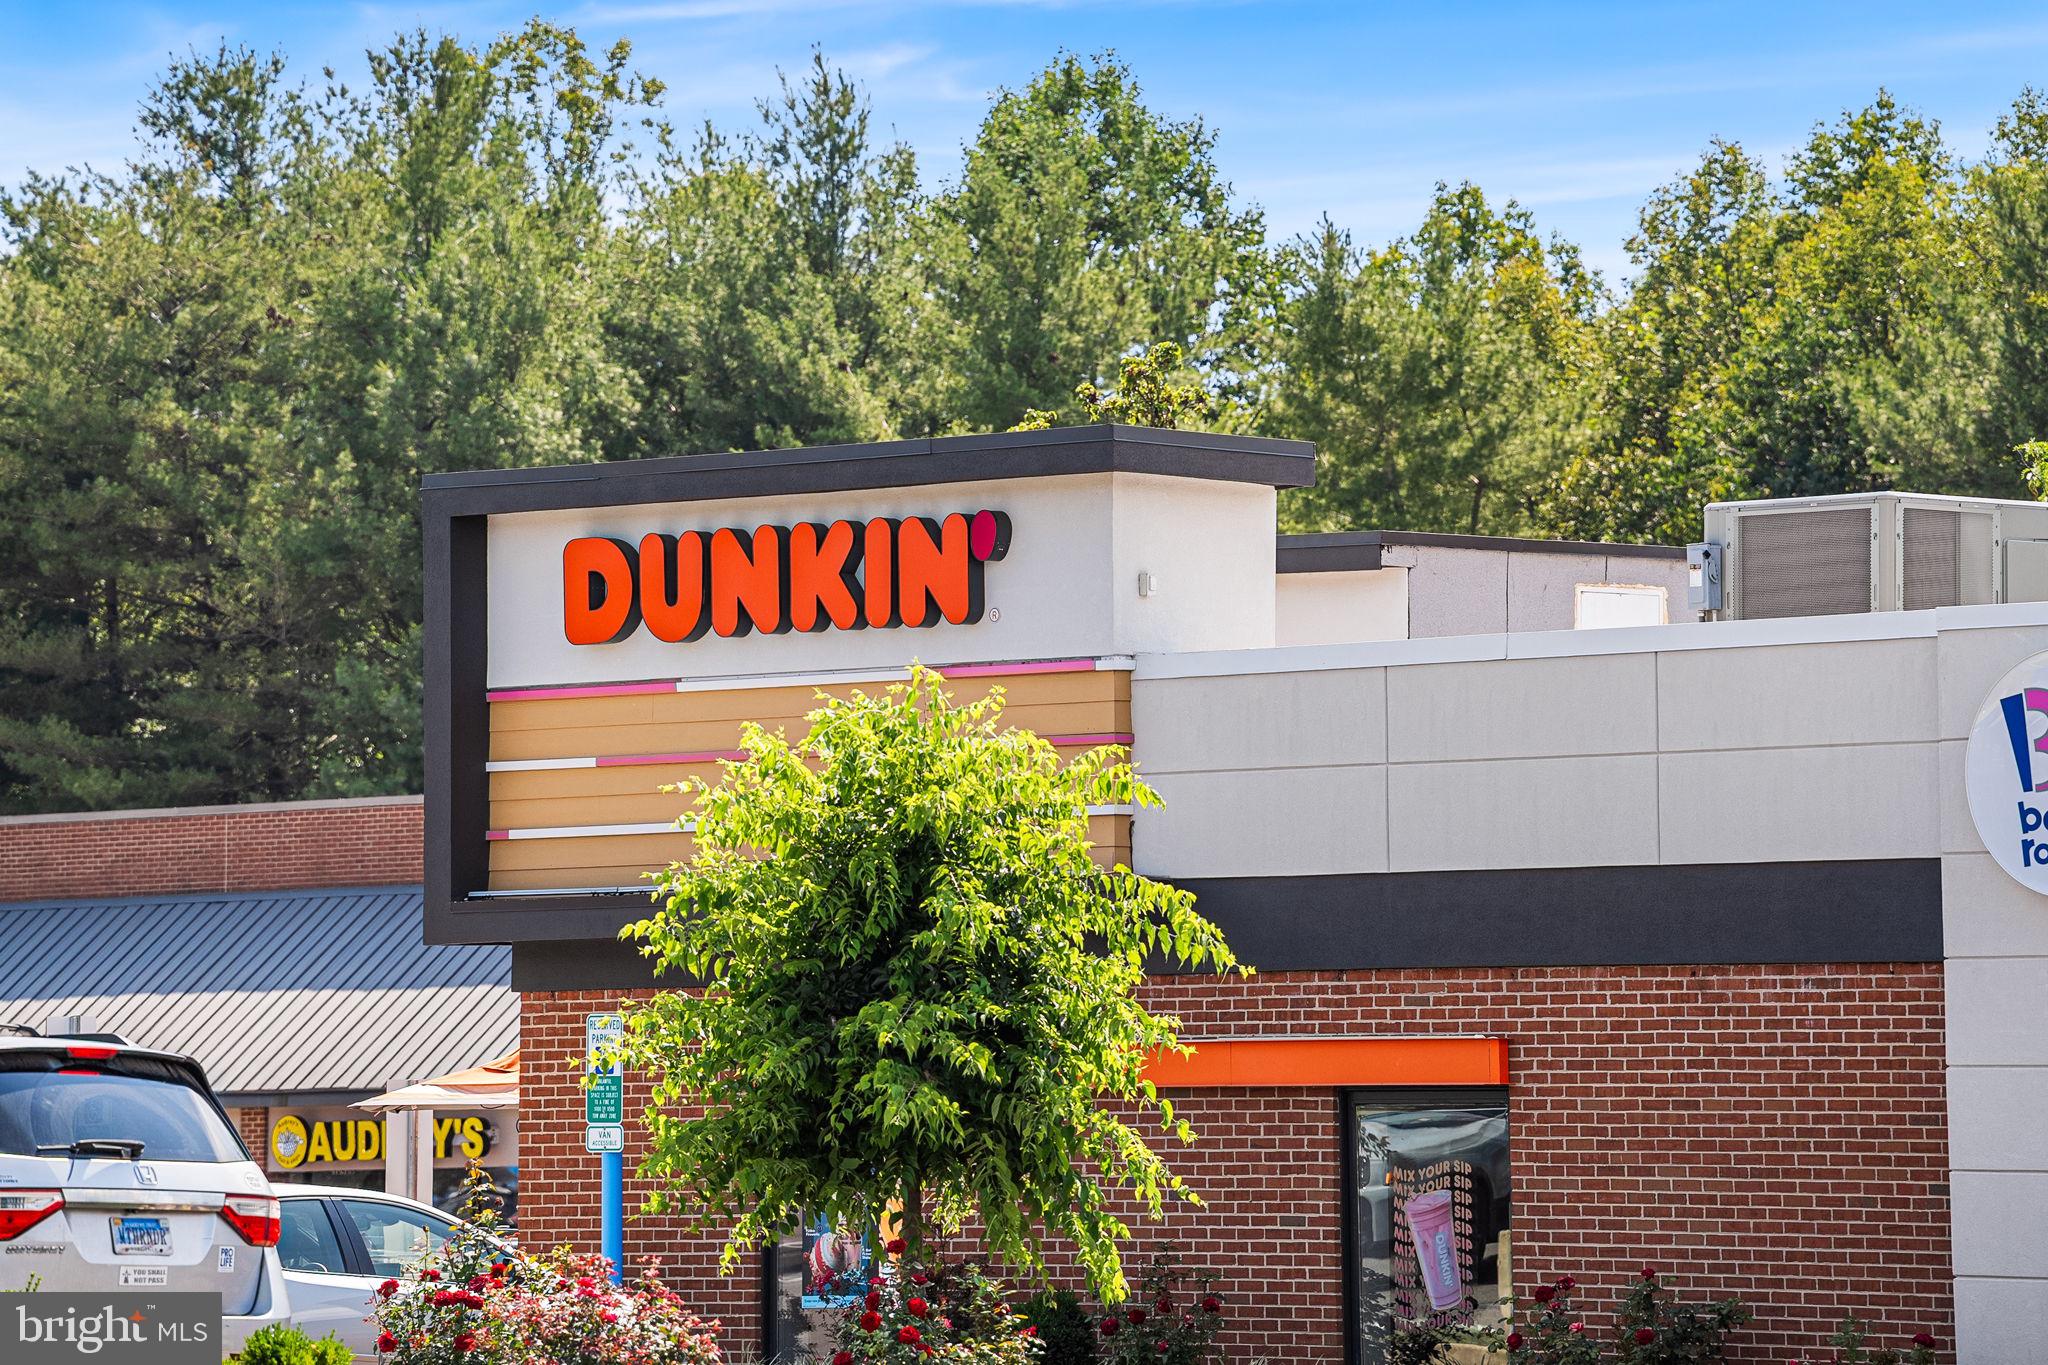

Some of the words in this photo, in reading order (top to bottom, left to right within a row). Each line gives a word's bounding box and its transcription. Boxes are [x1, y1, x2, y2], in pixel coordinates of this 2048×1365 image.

[562, 508, 1013, 646] DUNKIN'
[2017, 801, 2048, 834] b
[307, 1116, 485, 1163] AUDY'S
[598, 1131, 612, 1139] VAN
[1393, 1165, 1415, 1182] MIX
[1418, 1160, 1451, 1181] YOUR
[1453, 1160, 1472, 1175] SIP
[1393, 1180, 1415, 1198] MIX
[1418, 1176, 1451, 1194] YOUR
[1453, 1175, 1473, 1190] SIP
[1454, 1190, 1473, 1206] SIP
[1454, 1205, 1473, 1221] SIP
[1454, 1220, 1473, 1236] SIP
[220, 1248, 233, 1257] PRO
[1394, 1241, 1416, 1258] MIX
[219, 1257, 233, 1267] LIFE
[1394, 1256, 1416, 1273] MIX
[1394, 1272, 1416, 1288] MIX
[1460, 1267, 1474, 1282] IP
